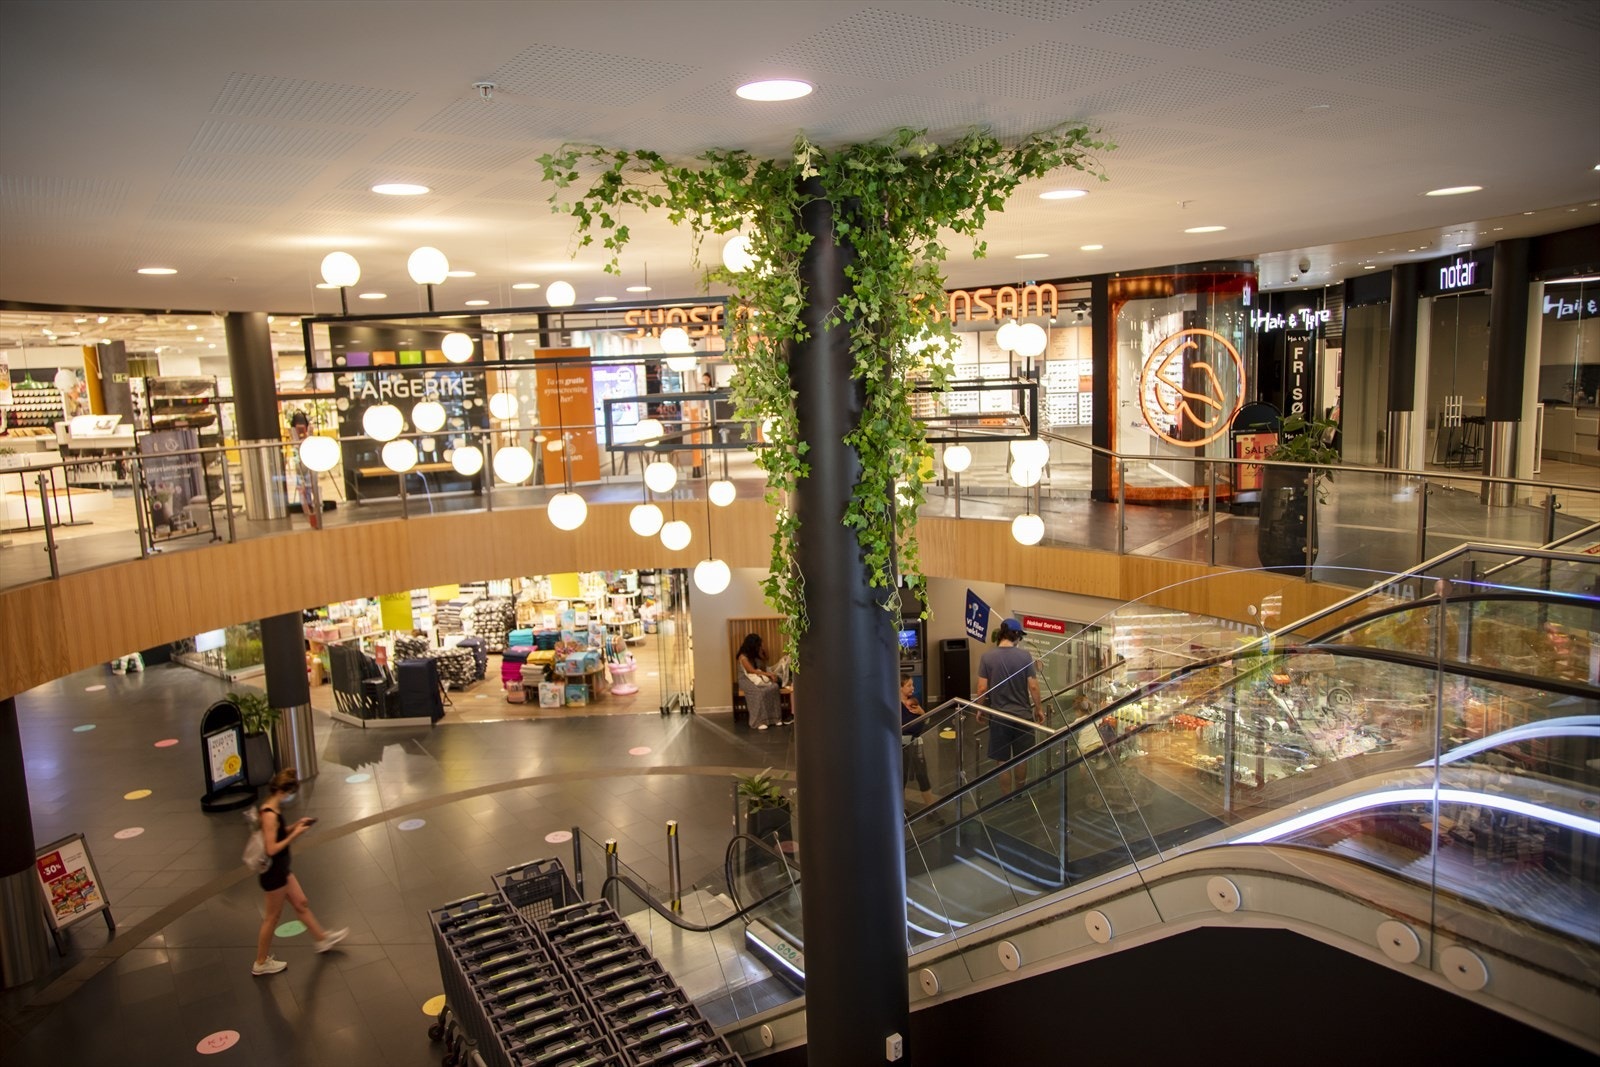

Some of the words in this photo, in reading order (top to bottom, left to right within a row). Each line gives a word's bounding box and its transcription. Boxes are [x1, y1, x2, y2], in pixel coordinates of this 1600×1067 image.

[1440, 258, 1475, 290] notar
[907, 283, 1058, 324] NSAM
[349, 377, 476, 401] FARGERIKE
[1291, 347, 1304, 415] FRISØ
[1043, 622, 1062, 631] Service
